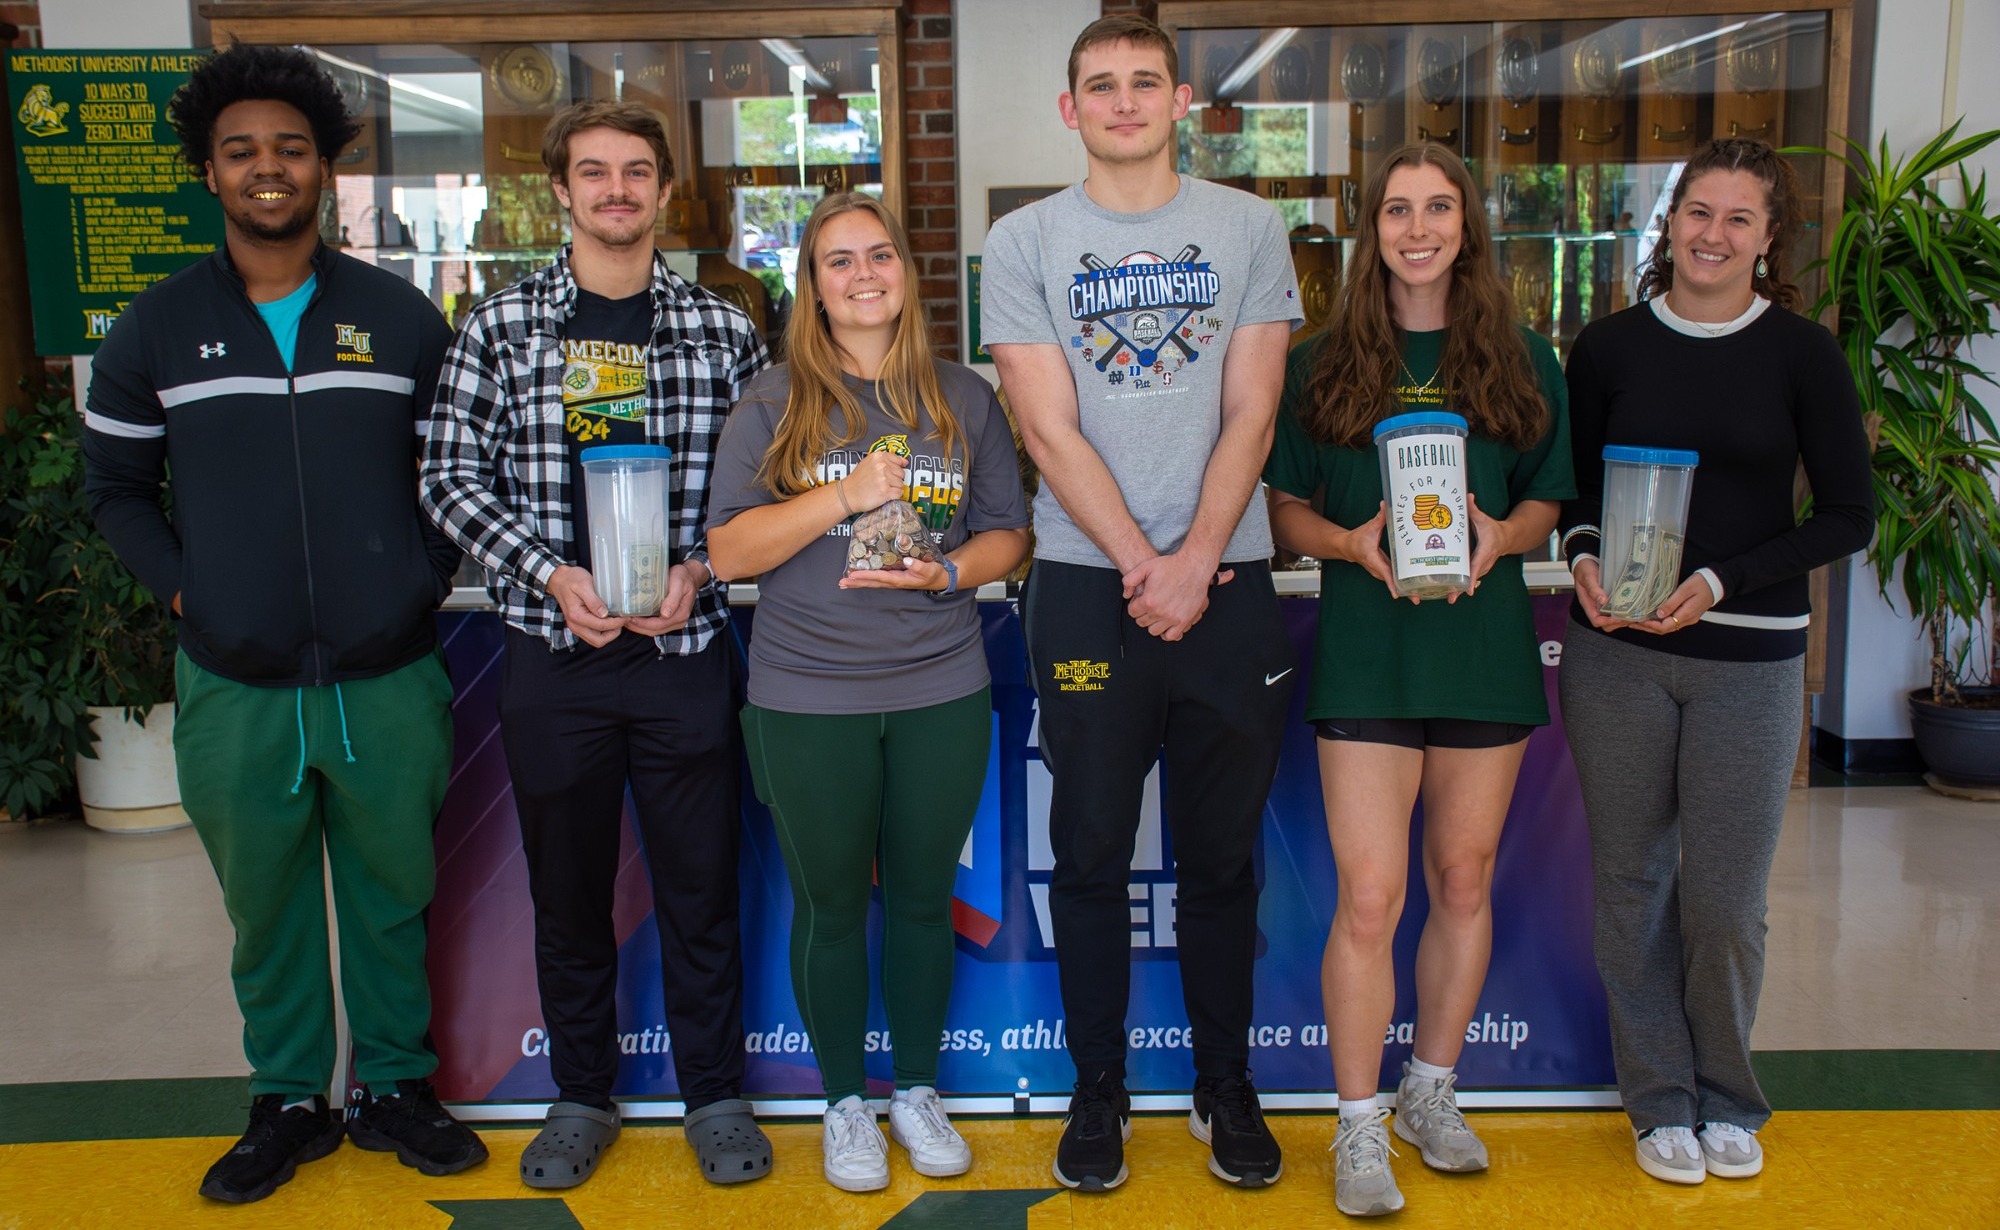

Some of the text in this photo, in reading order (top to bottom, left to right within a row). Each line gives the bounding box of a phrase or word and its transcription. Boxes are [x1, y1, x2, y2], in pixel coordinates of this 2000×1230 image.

[11, 55, 207, 73] METHODIST UNIVERSITY ATHLET
[84, 83, 148, 99] 10 WAYS TO
[79, 104, 156, 120] SUCCEED WITH
[85, 124, 154, 140] ZERO TALENT
[1099, 264, 1187, 279] ACC BASEBALL
[1070, 272, 1219, 319] CHAMPIONSHIP
[335, 324, 371, 354] MU
[336, 353, 374, 363] FOOTBALL
[1134, 378, 1152, 390] Pitt
[1396, 386, 1406, 394] of
[1417, 396, 1444, 404] Wesley
[1398, 444, 1457, 470] BASEBALL
[1396, 476, 1466, 546] PENNIES FOR A PURPOSE
[1053, 663, 1109, 679] METHODIST
[1060, 682, 1104, 691] BASKETBALL
